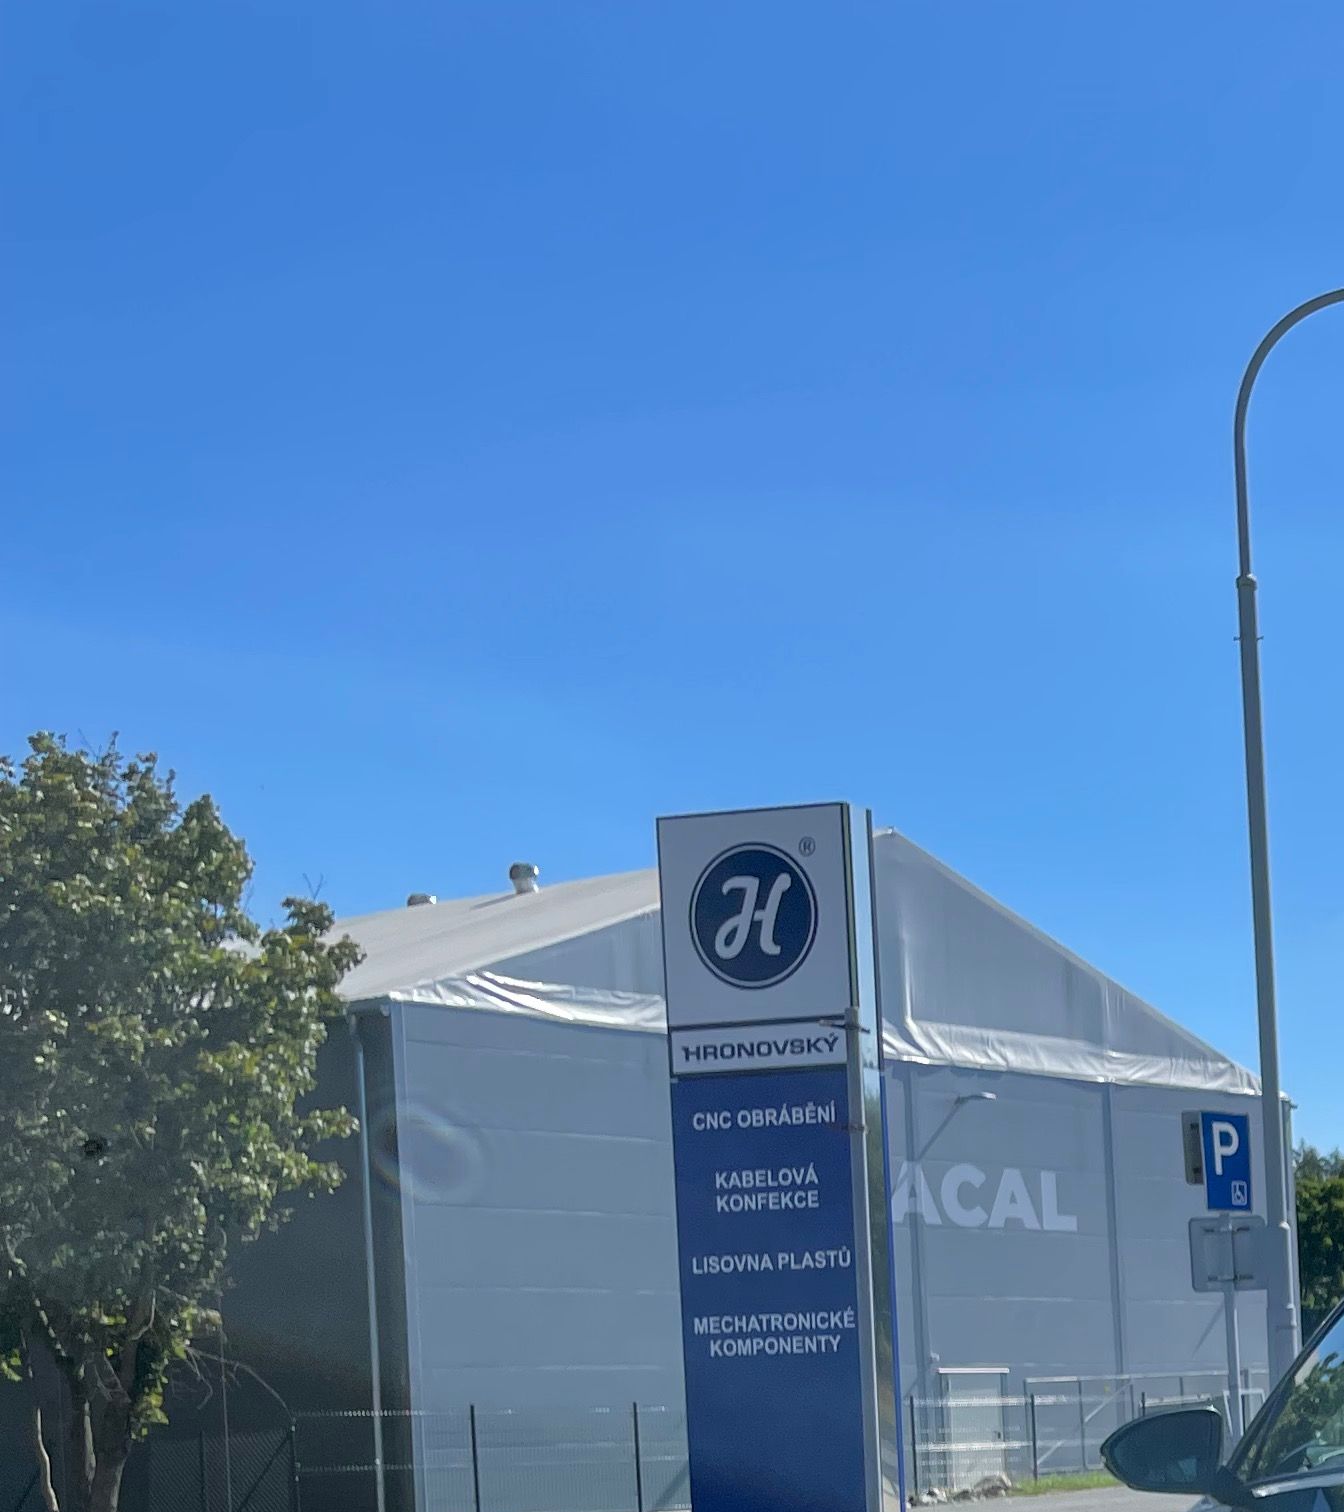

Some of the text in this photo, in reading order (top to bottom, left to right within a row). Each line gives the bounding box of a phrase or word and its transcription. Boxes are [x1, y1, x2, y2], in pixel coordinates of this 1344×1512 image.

[682, 1032, 839, 1063] HRONOVSKÝ
[692, 1100, 836, 1131] CNC OBRÁBĚNÍ
[1211, 1121, 1239, 1176] P
[715, 1162, 819, 1189] KABELOVÁ
[716, 1190, 820, 1213] KONFEKCE
[692, 1245, 851, 1275] LISOVNA PLASTŮ
[694, 1306, 856, 1336] MECHATRONICKÉ
[709, 1335, 841, 1358] KOMPONENTY
